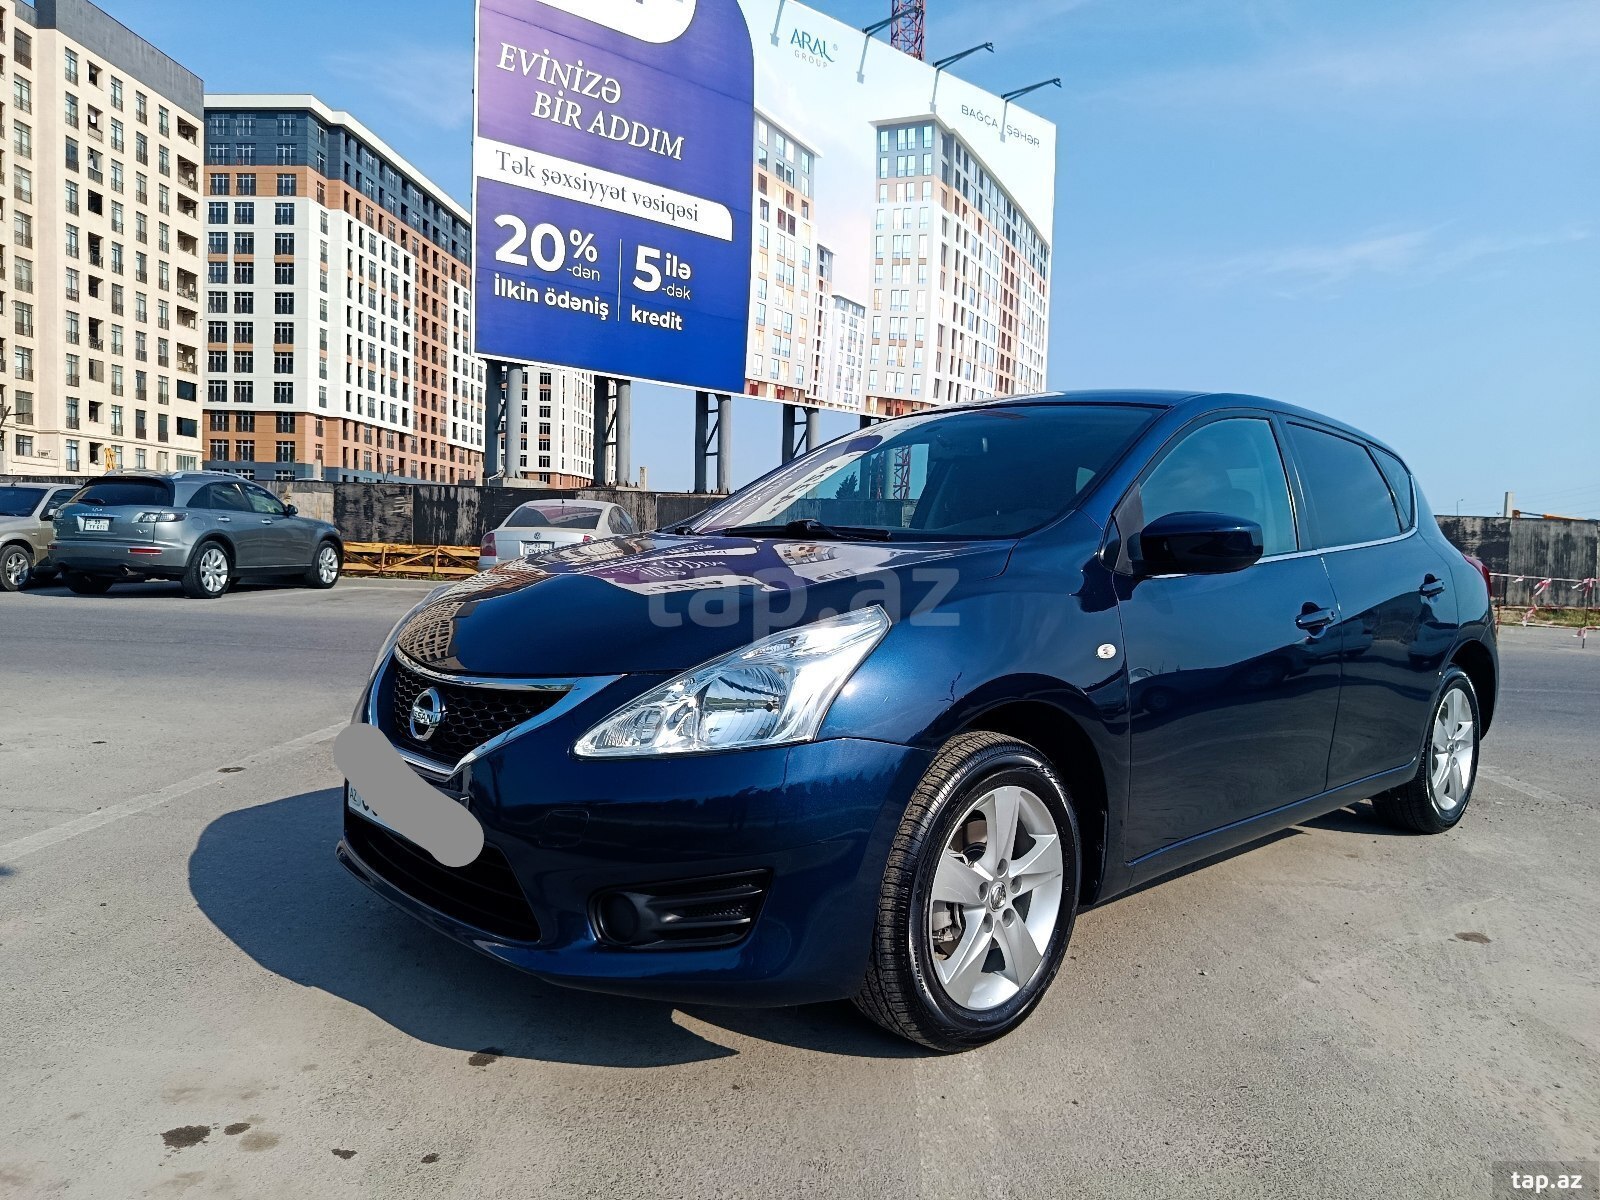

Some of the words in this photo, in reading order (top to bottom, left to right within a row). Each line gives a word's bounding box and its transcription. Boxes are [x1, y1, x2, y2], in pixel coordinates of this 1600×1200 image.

[790, 28, 835, 63] ARAL
[794, 49, 828, 68] GROUP
[496, 42, 622, 104] EVİNİZƏ
[531, 90, 582, 130] BİR
[586, 110, 685, 161] ADDIM
[495, 149, 536, 179] Tək
[541, 168, 627, 203] şəxsiyyət
[632, 193, 699, 222] vəsiqəsi
[632, 244, 662, 292] 5
[665, 252, 692, 280] ilə
[544, 287, 609, 321] ödəniş
[631, 304, 683, 331] kredit
